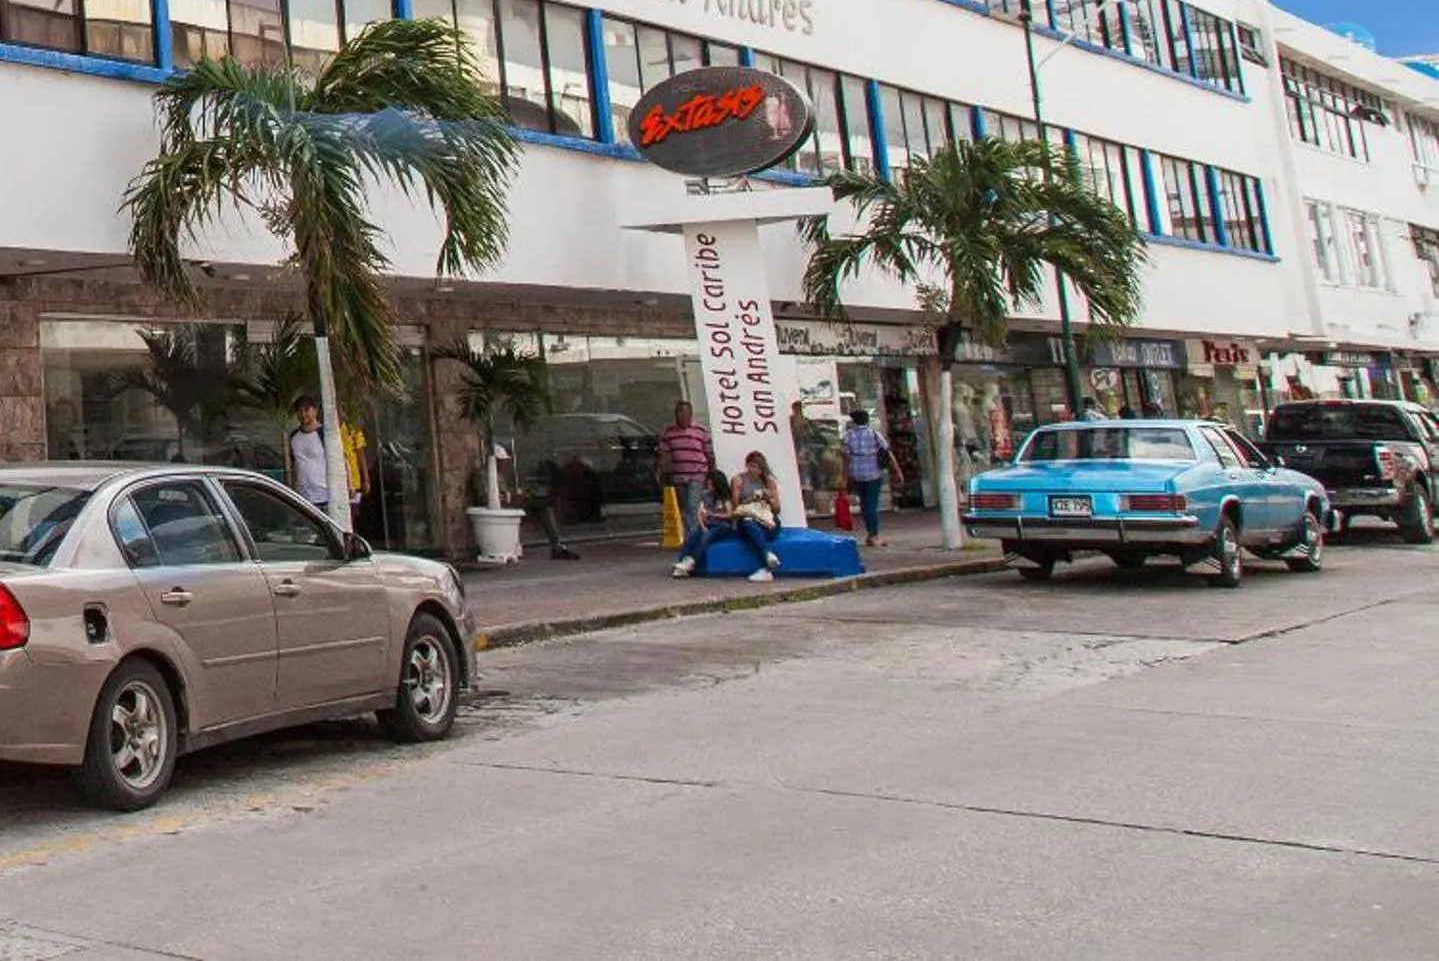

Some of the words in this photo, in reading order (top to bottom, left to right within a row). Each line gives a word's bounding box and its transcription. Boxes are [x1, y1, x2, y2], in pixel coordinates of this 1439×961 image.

[694, 232, 727, 311] Caribe
[705, 321, 735, 359] Sol
[712, 370, 746, 435] Hotel
[753, 389, 779, 434] San
